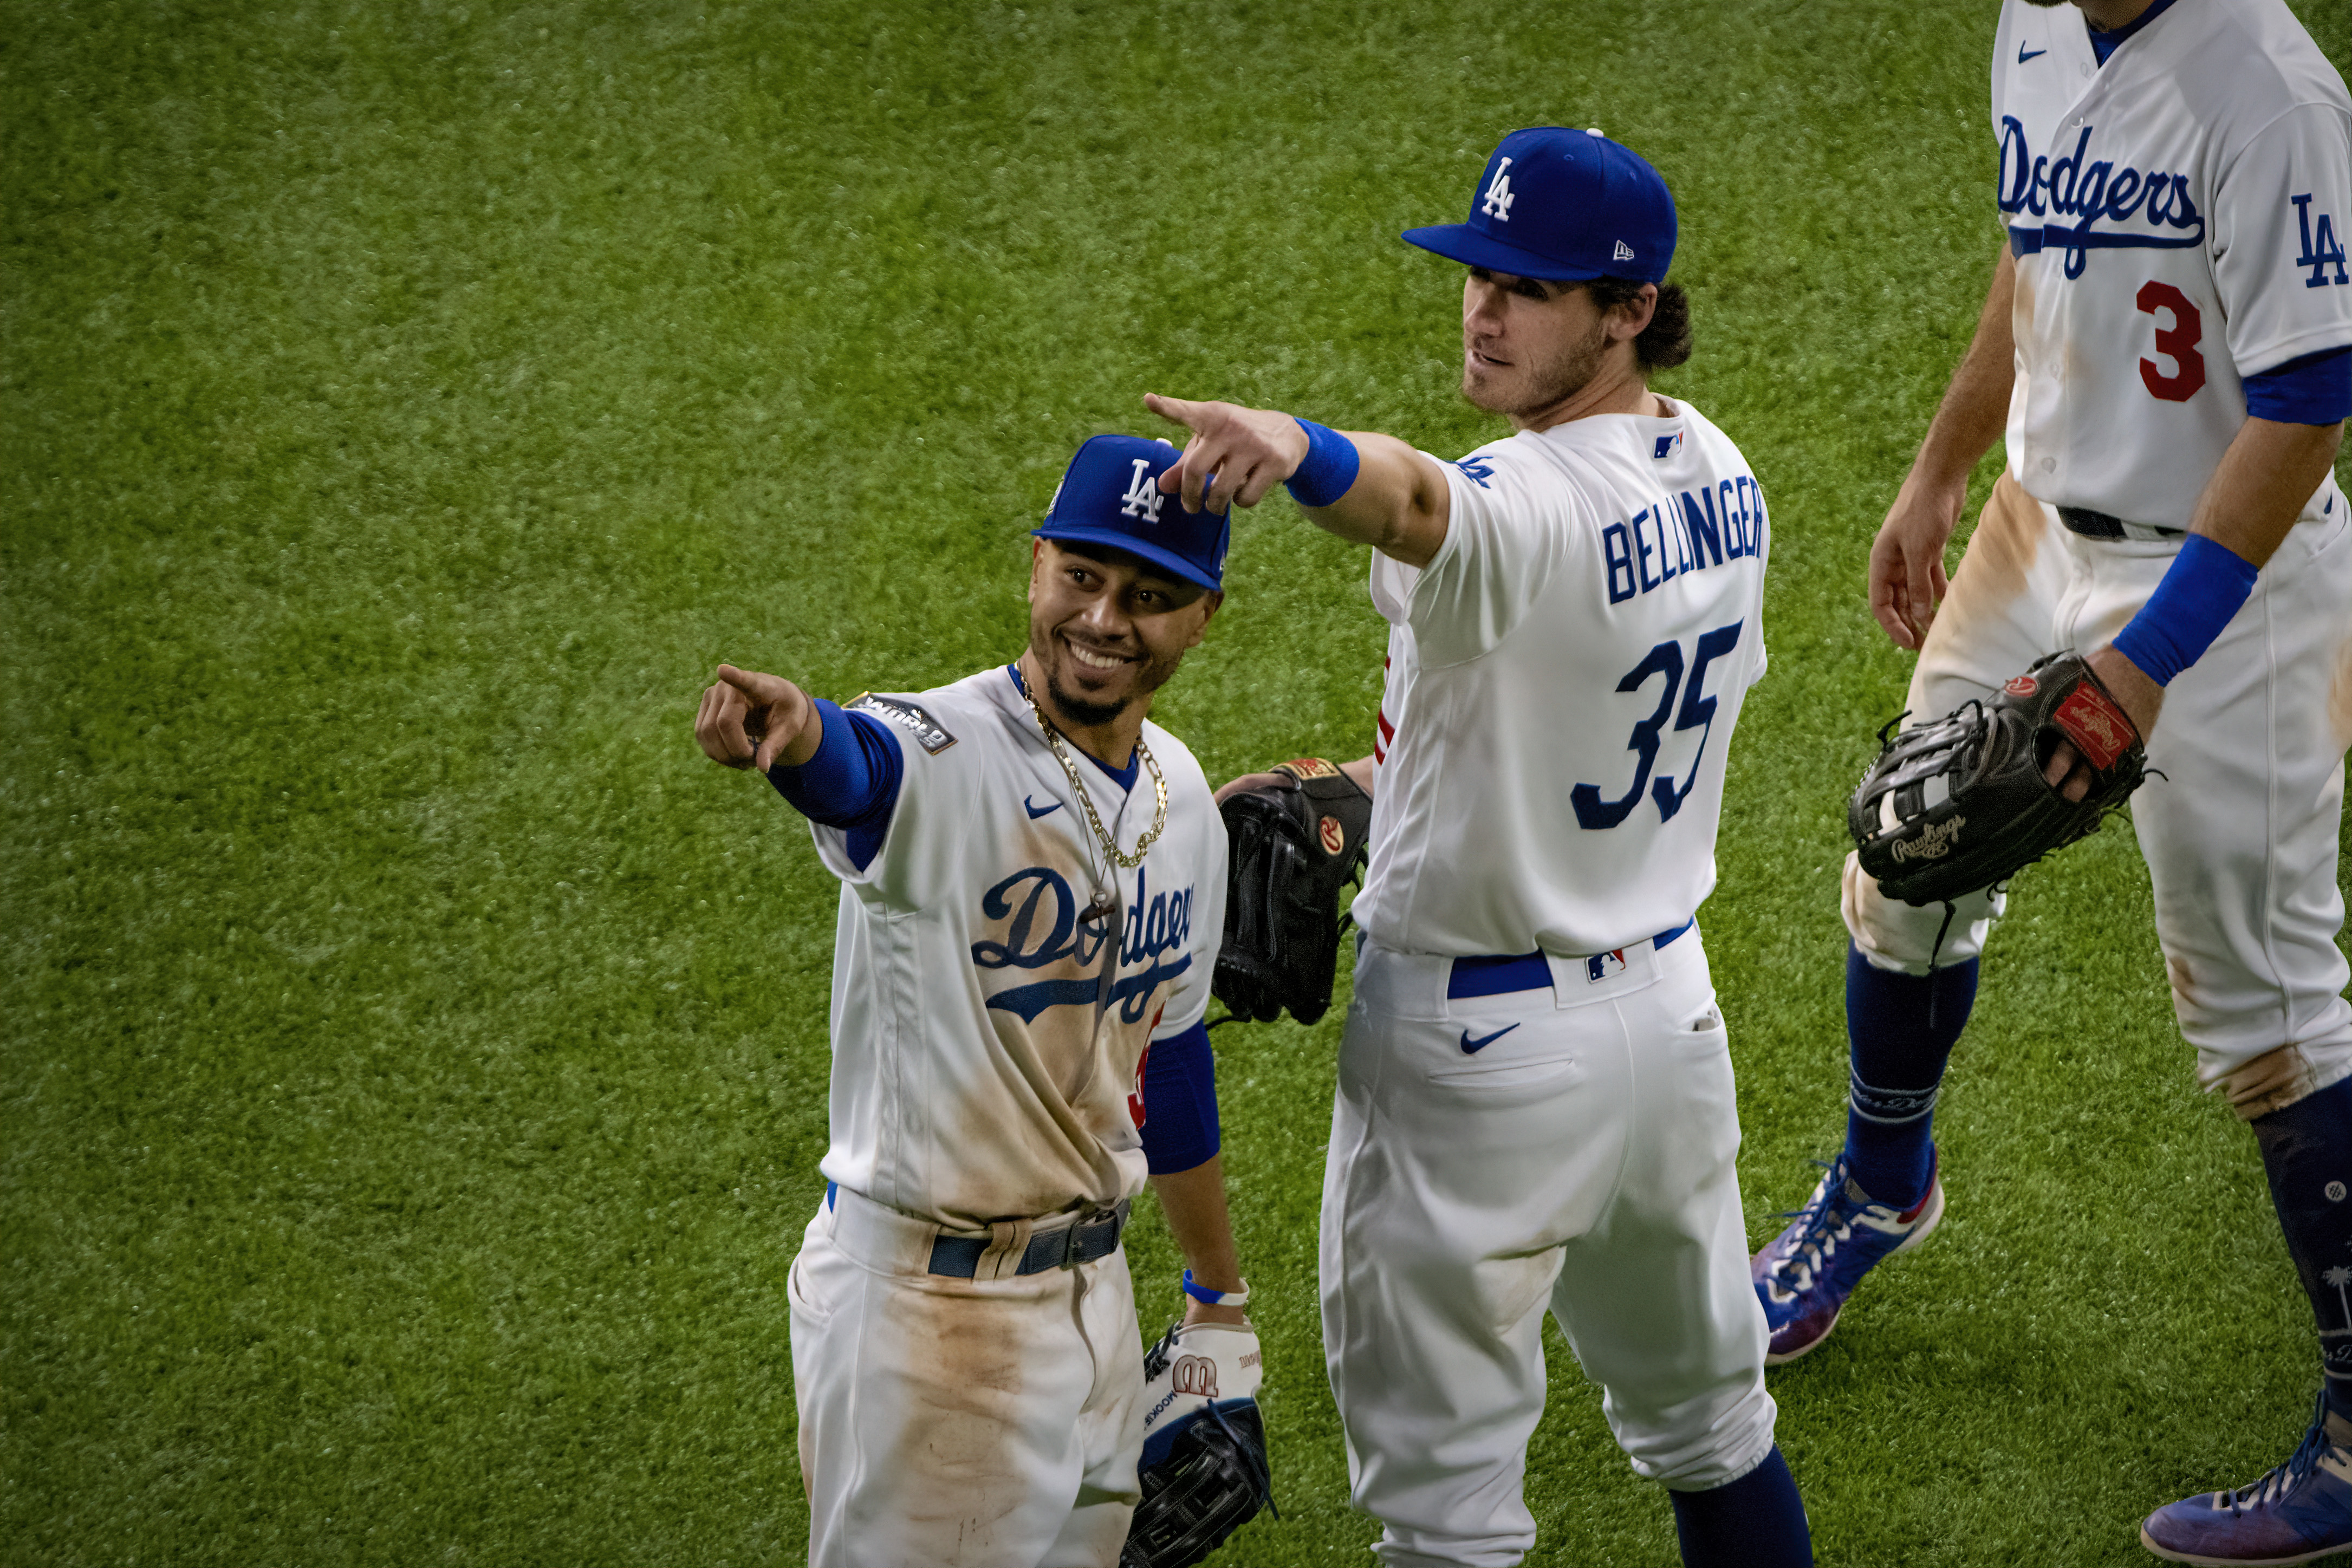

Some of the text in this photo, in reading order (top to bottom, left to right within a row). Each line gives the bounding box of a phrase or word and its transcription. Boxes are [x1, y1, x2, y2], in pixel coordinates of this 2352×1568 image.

[1482, 157, 1515, 222] LA
[1998, 115, 2204, 280] Dodgers
[2291, 193, 2349, 288] LA
[2136, 280, 2206, 402] 3
[1121, 458, 1164, 524] LA
[1602, 475, 1763, 605] BELLINGER
[857, 696, 948, 743] WORLD
[1570, 617, 1744, 830] 35
[1892, 814, 1966, 863] Rawlings
[1145, 1389, 1178, 1427] MOOKIE
